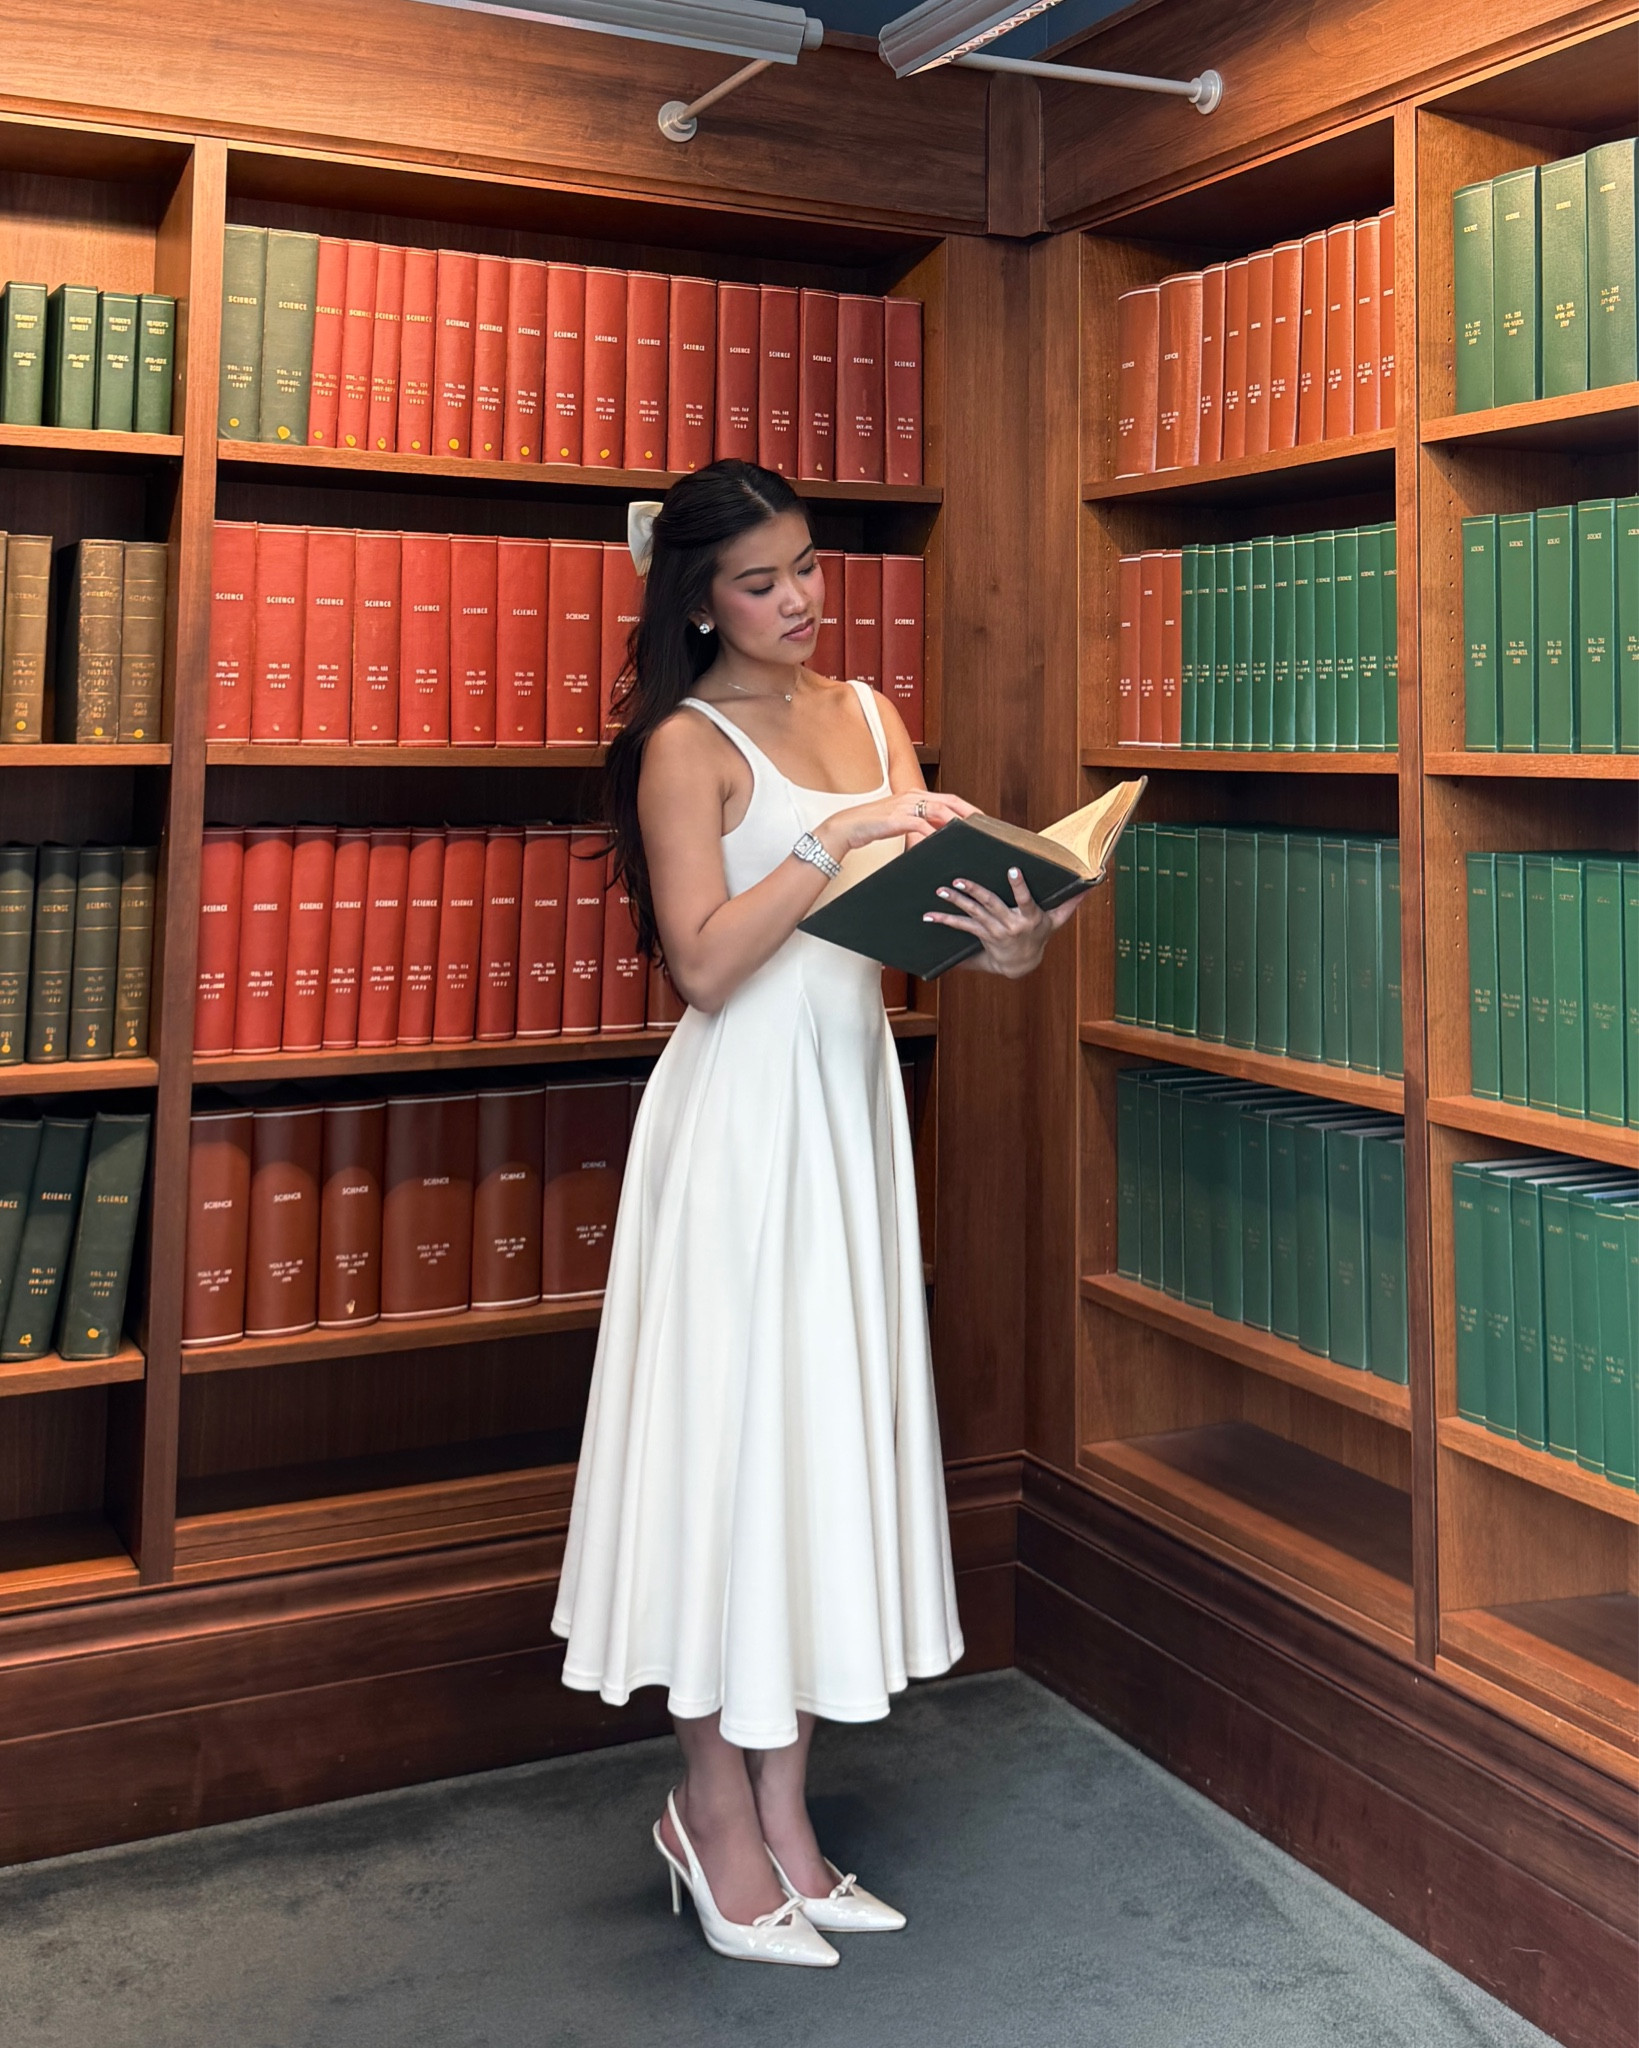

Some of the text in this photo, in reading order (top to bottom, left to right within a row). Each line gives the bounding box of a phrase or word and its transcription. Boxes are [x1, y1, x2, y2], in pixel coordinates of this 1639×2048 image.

[228, 296, 257, 304] SCIENCE
[279, 302, 307, 310] SCIENCE
[316, 306, 342, 314] SCIENCE
[446, 318, 469, 328] SCIENCE
[479, 324, 502, 332] SCIENCE
[518, 328, 540, 336] SCIENCE
[683, 344, 704, 352] SCIENCE
[342, 1186, 368, 1194] SCIENCE
[98, 1195, 128, 1203] SCIENCE
[274, 1193, 301, 1202] SCIENCE
[204, 1201, 232, 1209] SCIENCE
